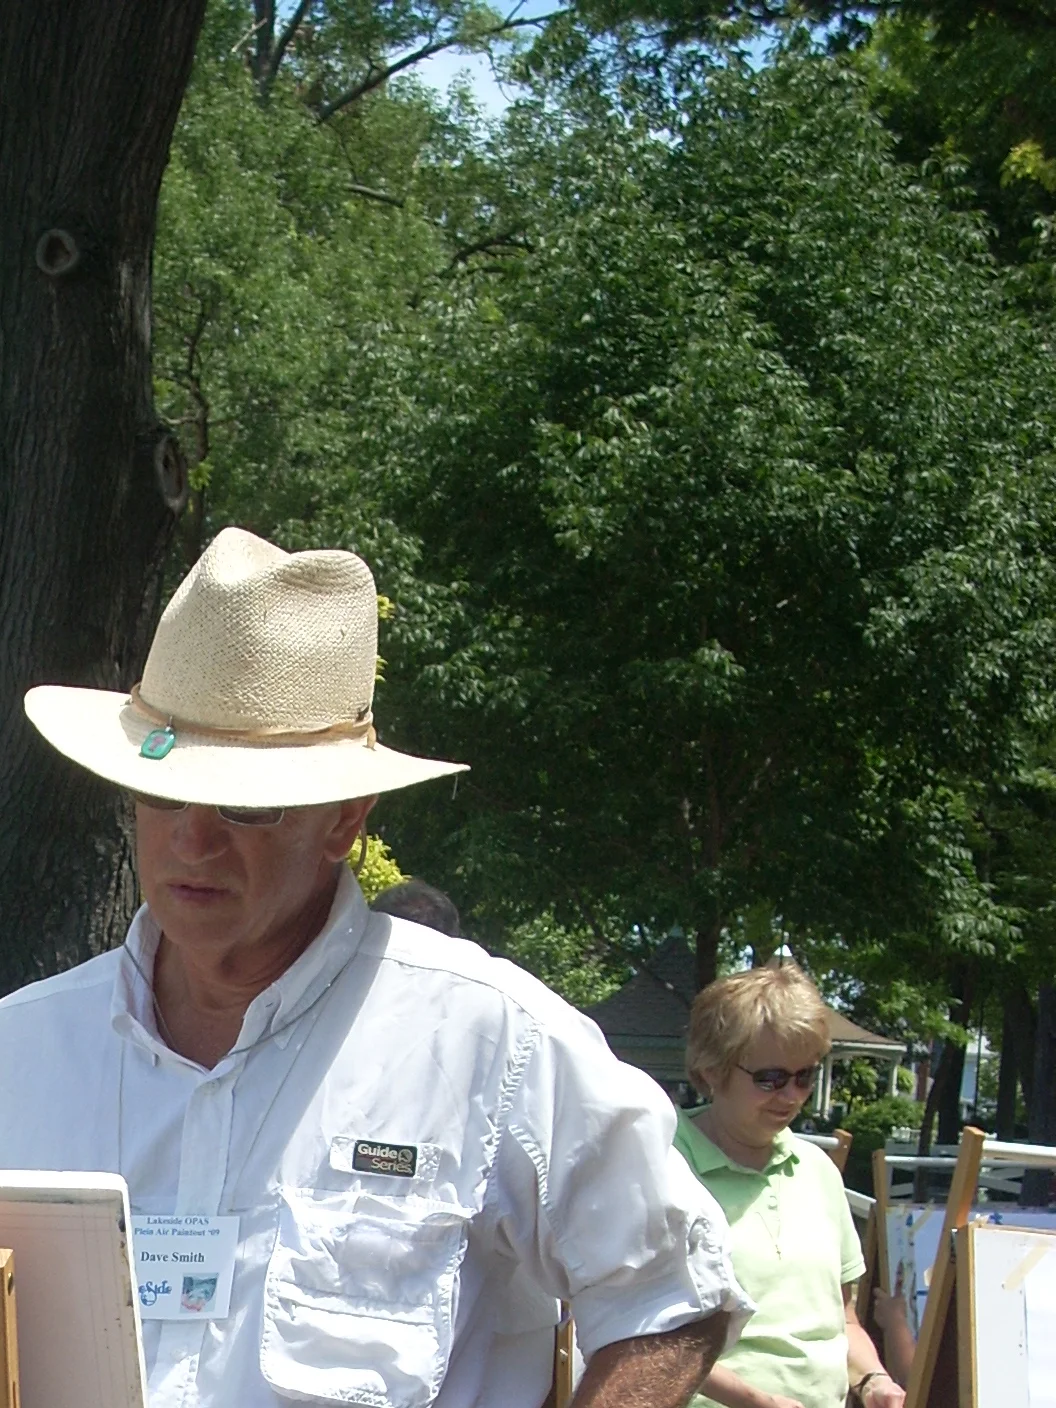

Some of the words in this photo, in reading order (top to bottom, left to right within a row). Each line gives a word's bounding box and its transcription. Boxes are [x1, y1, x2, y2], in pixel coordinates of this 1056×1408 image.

[357, 1143, 398, 1159] Guide
[371, 1158, 411, 1173] Series
[147, 1217, 182, 1225] Lakeside
[140, 1251, 169, 1262] Dave
[171, 1251, 205, 1263] Smith
